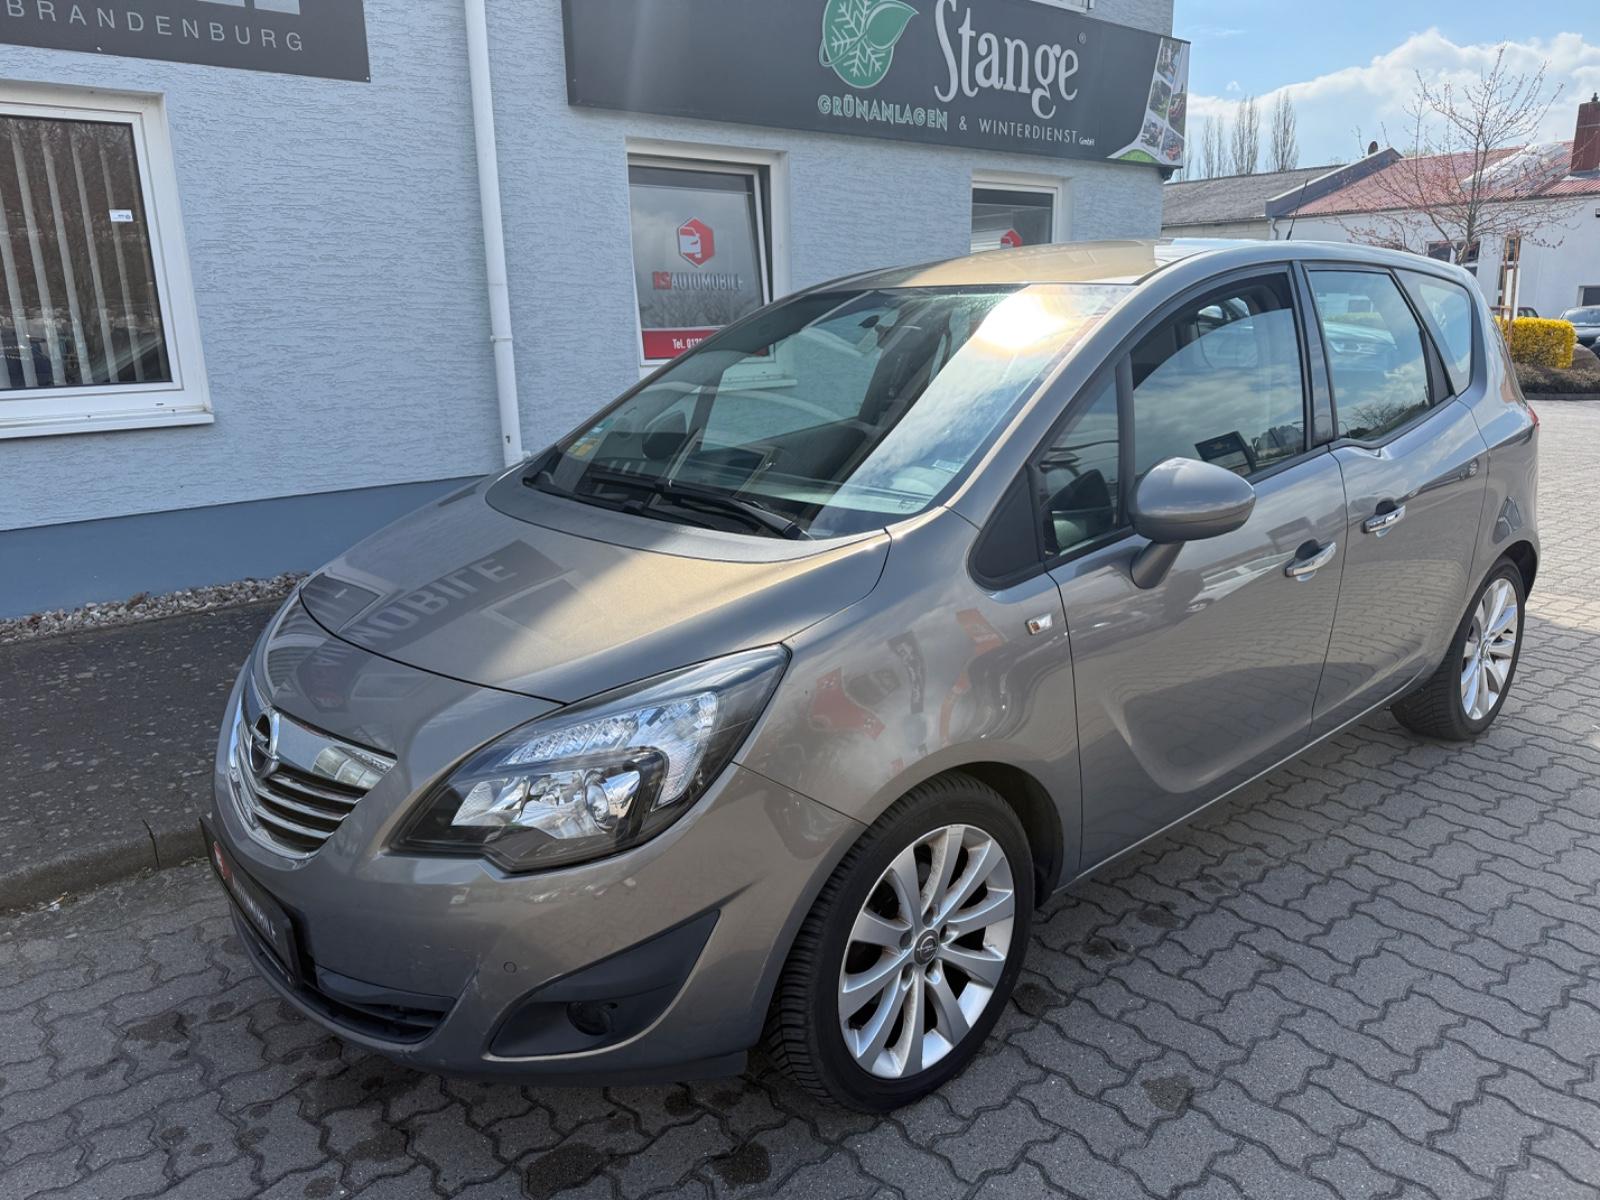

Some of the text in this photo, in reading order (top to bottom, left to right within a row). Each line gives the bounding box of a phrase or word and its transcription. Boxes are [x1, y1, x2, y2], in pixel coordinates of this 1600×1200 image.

[6, 0, 303, 51] BRANDENBURG
[934, 0, 1079, 119] Stange
[817, 94, 948, 132] GRÜNANLAGEN
[958, 115, 968, 131] &
[978, 118, 1078, 144] WINTERDIENST
